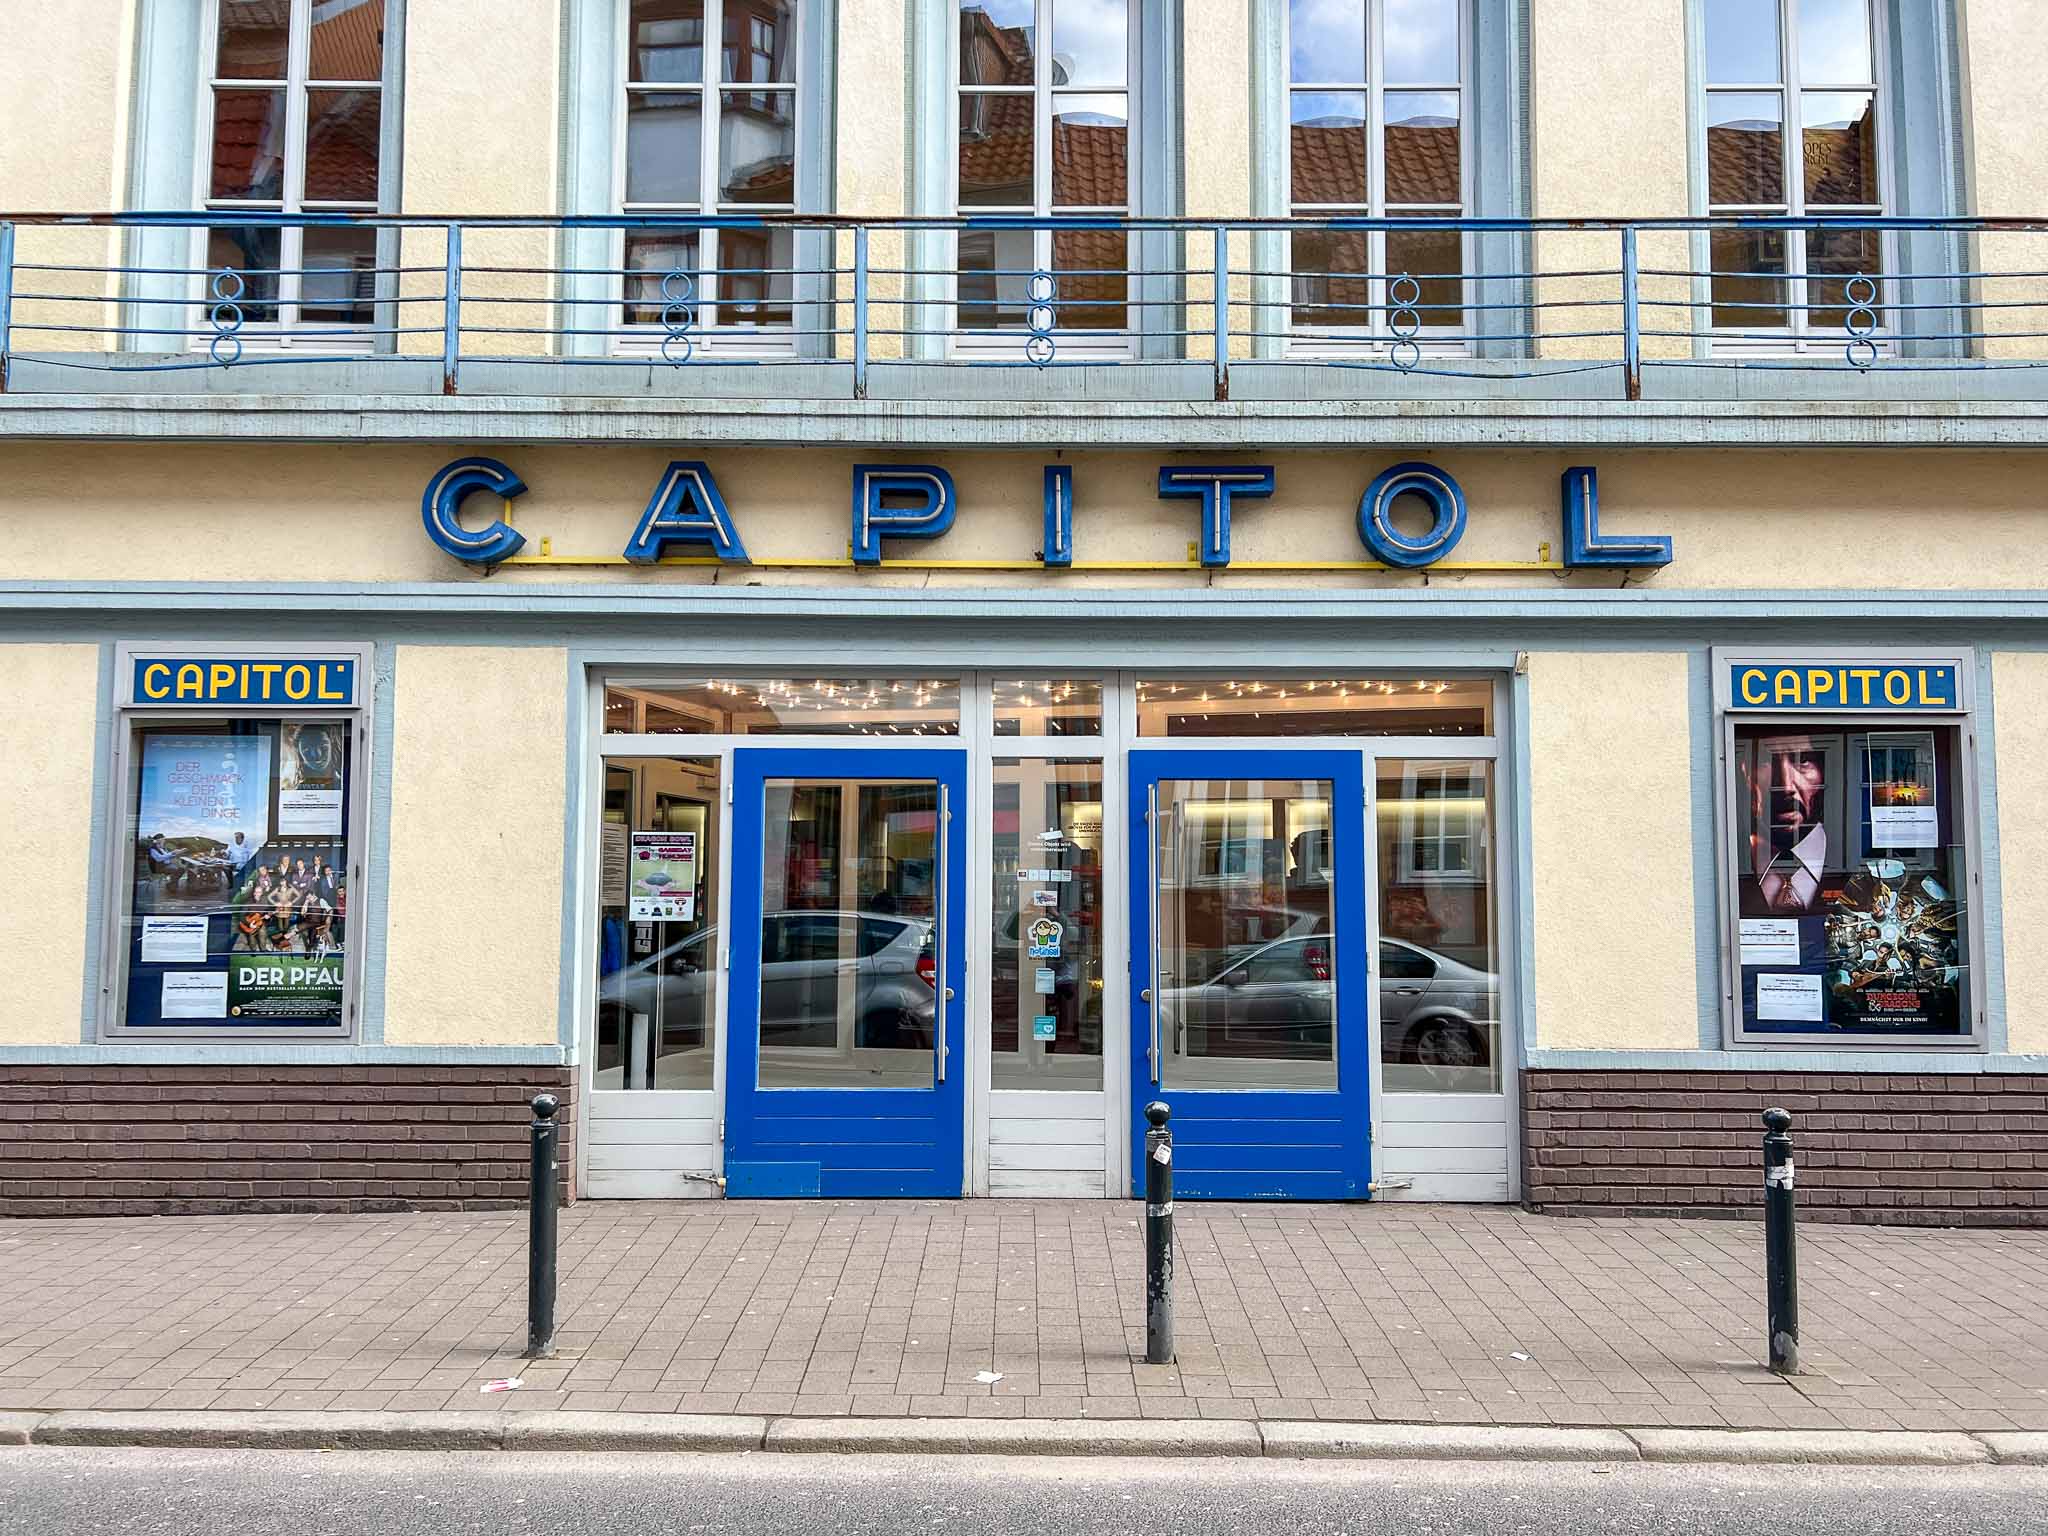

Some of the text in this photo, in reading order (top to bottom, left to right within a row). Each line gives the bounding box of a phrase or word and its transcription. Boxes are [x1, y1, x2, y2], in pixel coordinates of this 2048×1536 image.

[422, 457, 1672, 568] CAPITOL
[144, 663, 344, 700] CAPITOL
[1741, 669, 1945, 705] CAPITOL
[176, 761, 200, 772] DER
[168, 773, 245, 784] GESCHMACK
[191, 784, 216, 795] DER
[174, 795, 224, 806] KLEINEN
[201, 807, 241, 818] DINGE
[240, 967, 344, 986] DER PFAU
